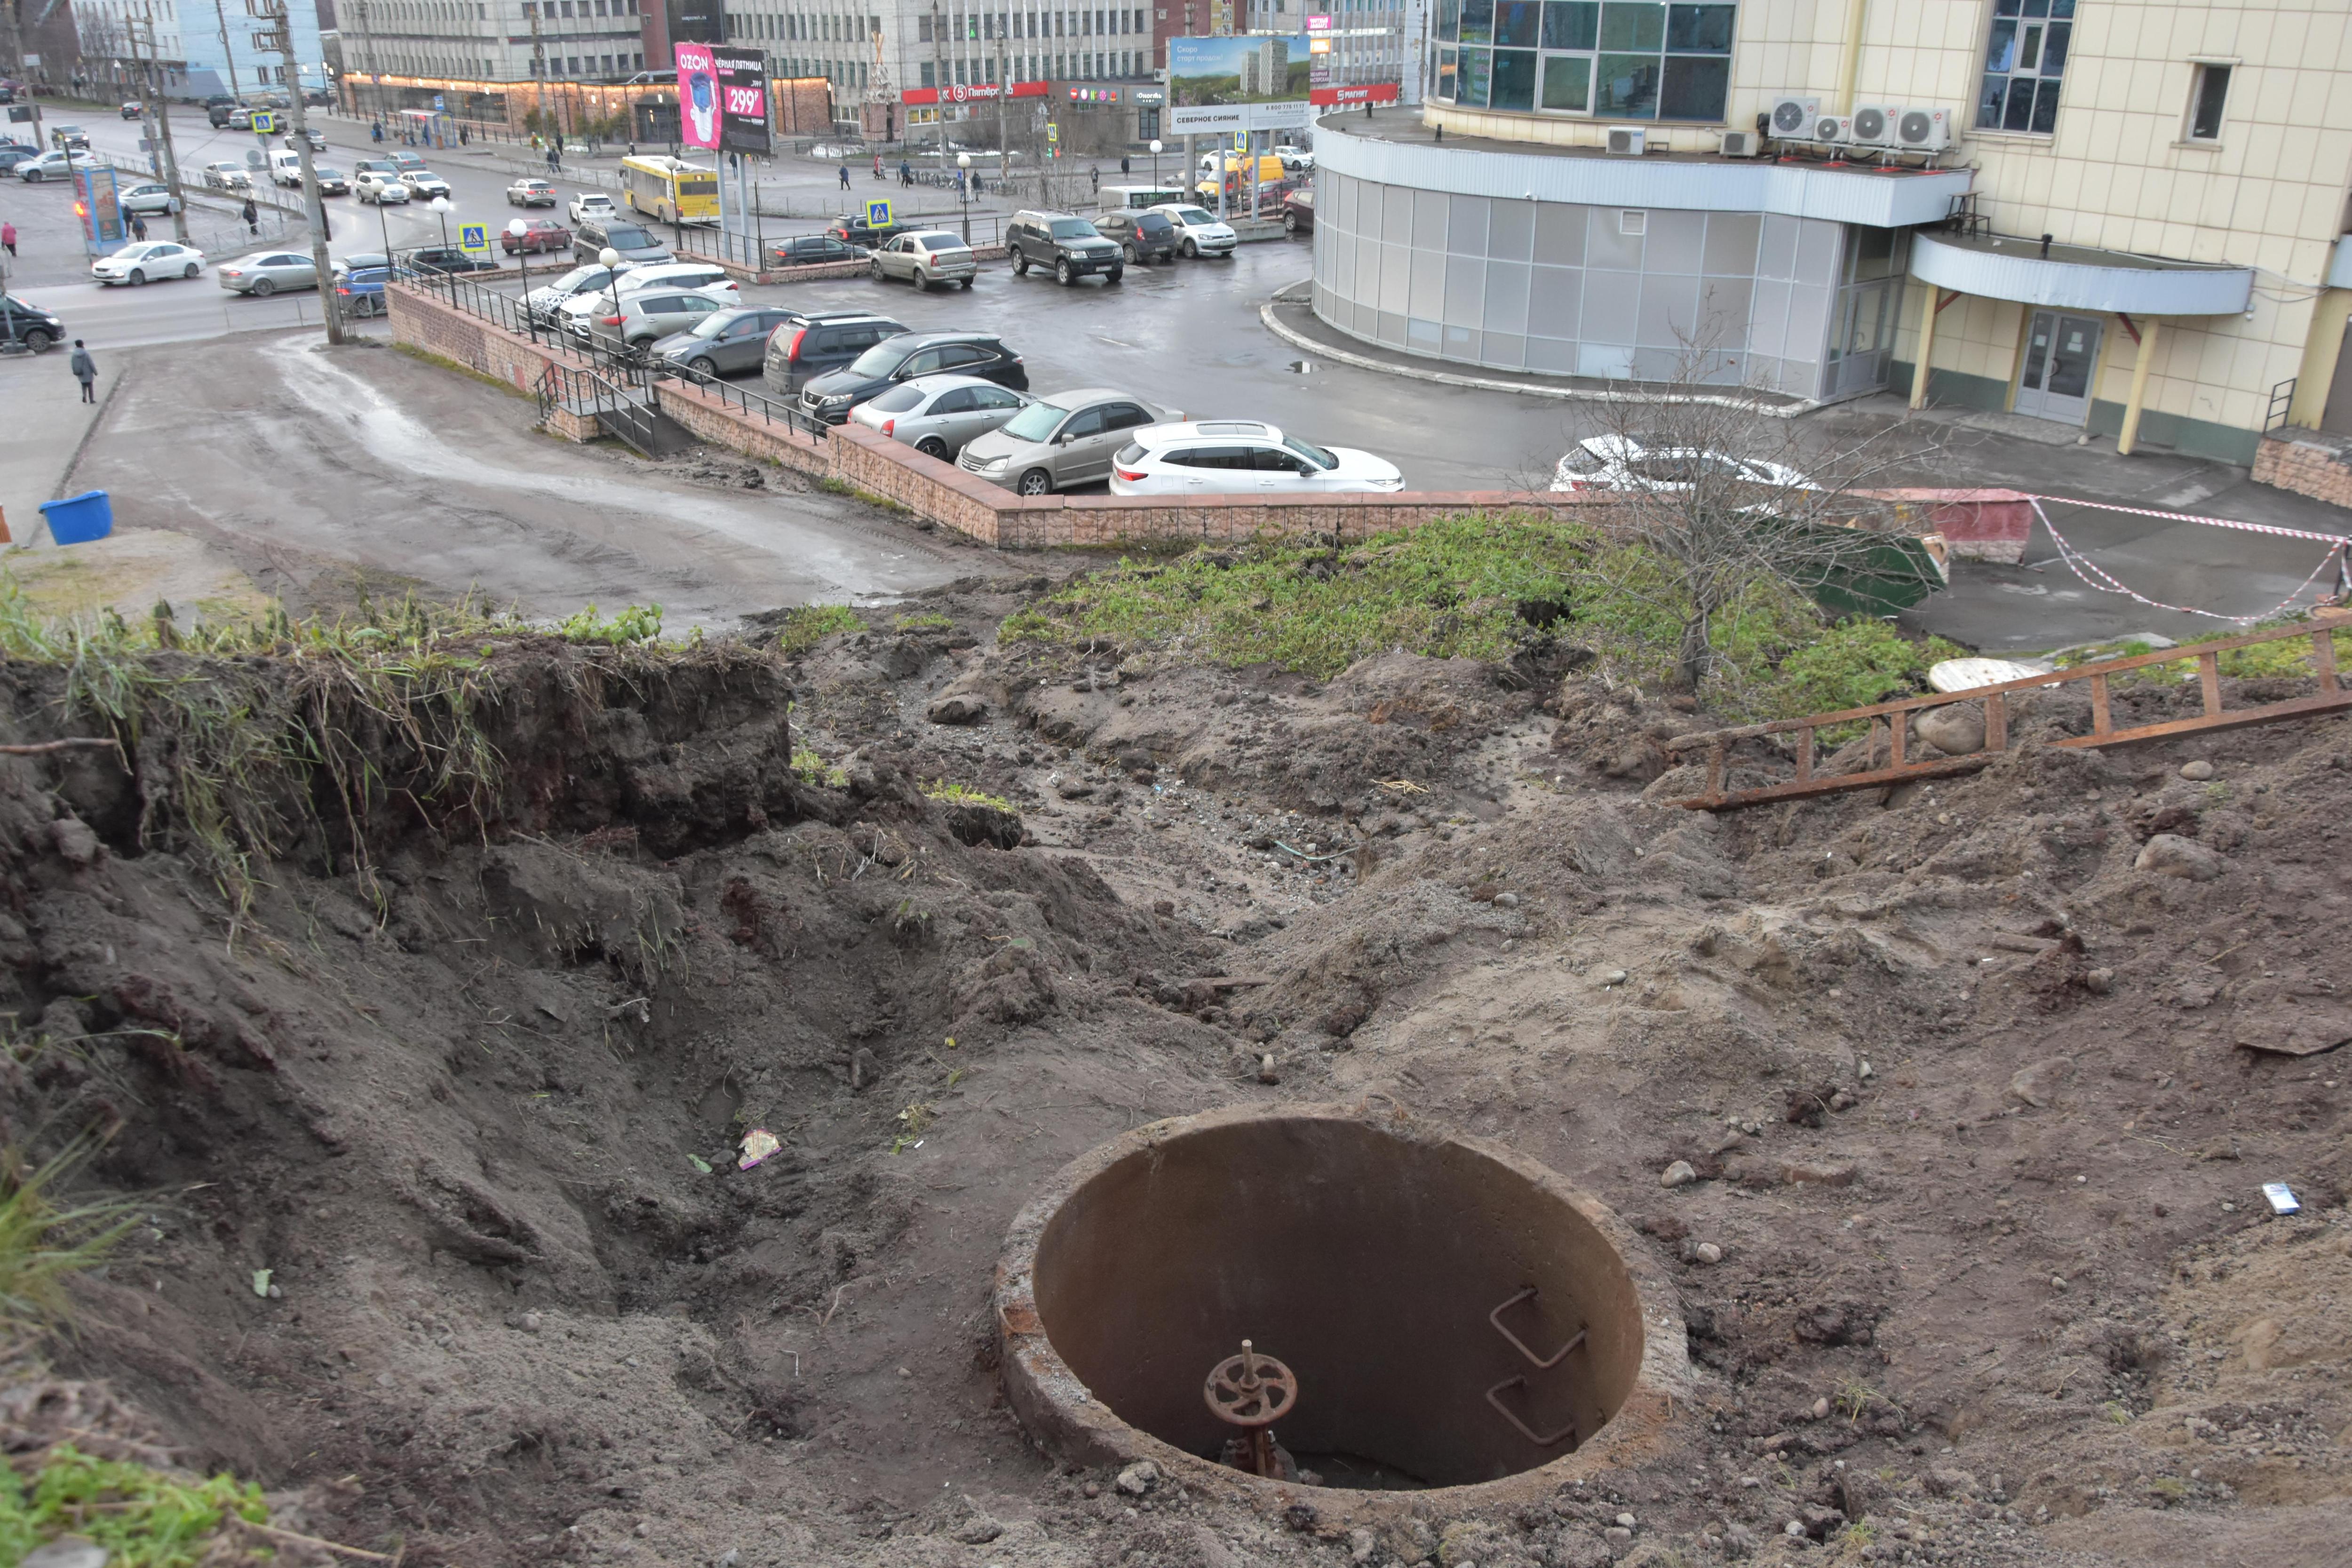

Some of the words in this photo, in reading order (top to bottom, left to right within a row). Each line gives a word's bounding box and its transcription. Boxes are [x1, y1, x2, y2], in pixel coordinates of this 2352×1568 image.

[1177, 46, 1198, 54] Скоро
[680, 53, 709, 71] OZON
[715, 57, 735, 69] ЧЁРНАЯ
[735, 59, 763, 72] ПЯТНИЦА
[1344, 90, 1368, 99] МАГНИТ
